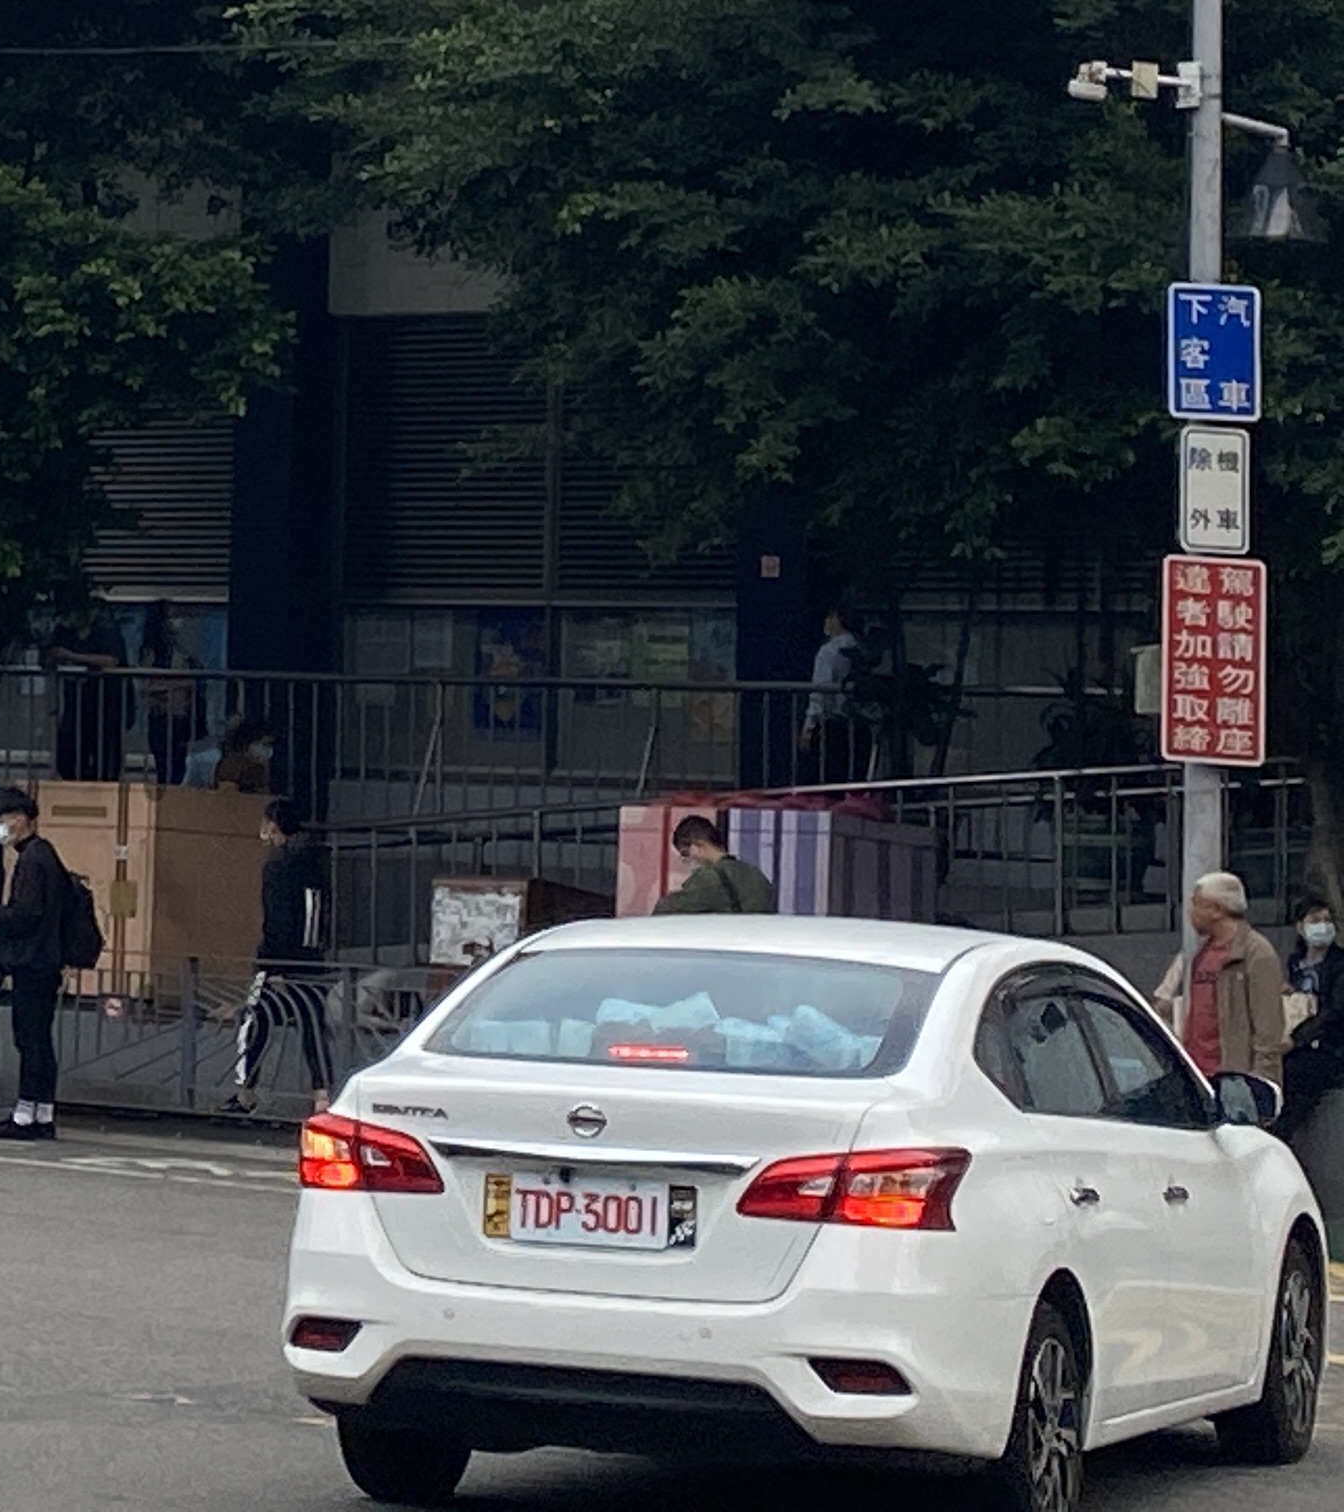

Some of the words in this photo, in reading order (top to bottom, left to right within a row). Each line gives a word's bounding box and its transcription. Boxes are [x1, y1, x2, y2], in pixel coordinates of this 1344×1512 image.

[1178, 293, 1212, 409] 下客區
[1218, 295, 1251, 412] 汽車
[1188, 447, 1212, 531] 除外
[1216, 449, 1240, 531] 機車
[1172, 564, 1211, 752] 違者加強取締
[1216, 566, 1254, 757] 駕駛請勿離座
[515, 1187, 658, 1236] TDP-3001
